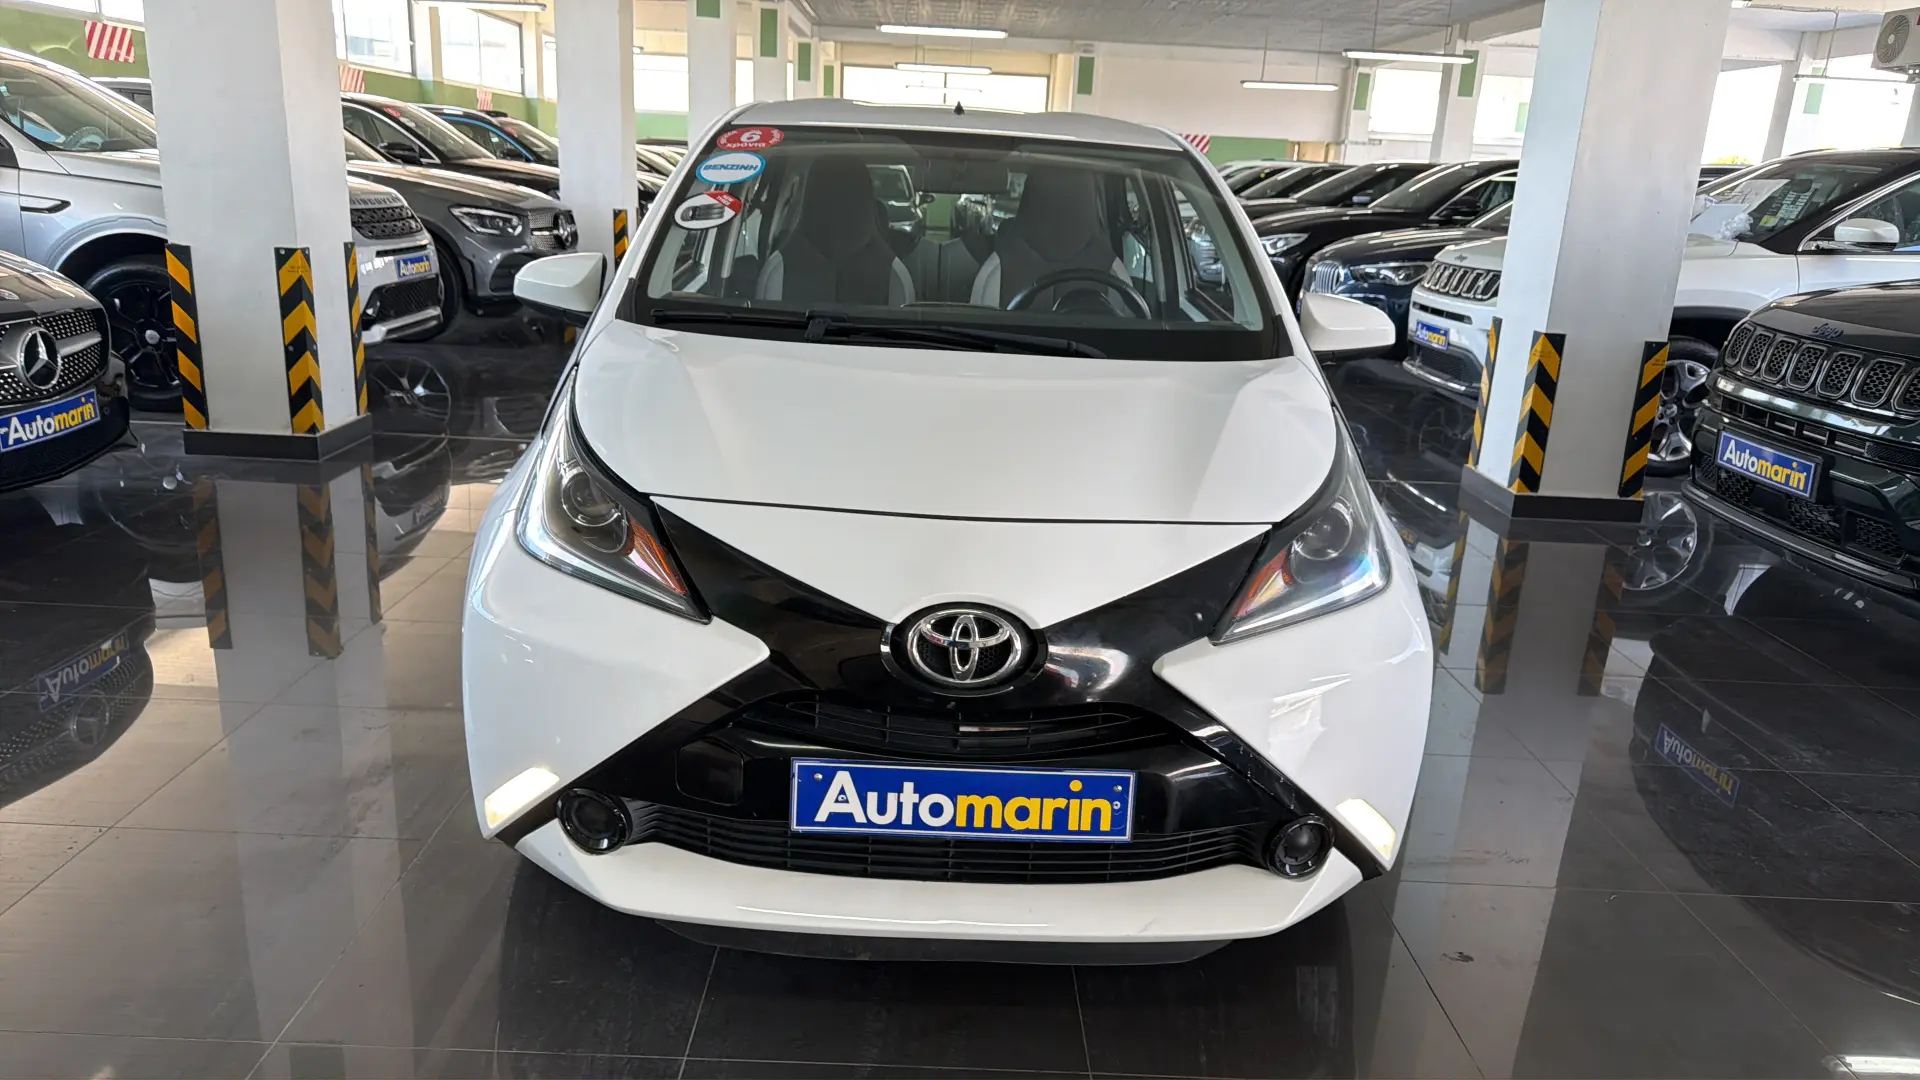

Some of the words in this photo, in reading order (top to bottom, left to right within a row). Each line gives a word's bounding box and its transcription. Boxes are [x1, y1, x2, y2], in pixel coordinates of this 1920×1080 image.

[740, 130, 762, 143] 6
[8, 396, 95, 446] Automarin
[1723, 439, 1806, 491] Automarin
[814, 770, 1112, 831] Automarin
